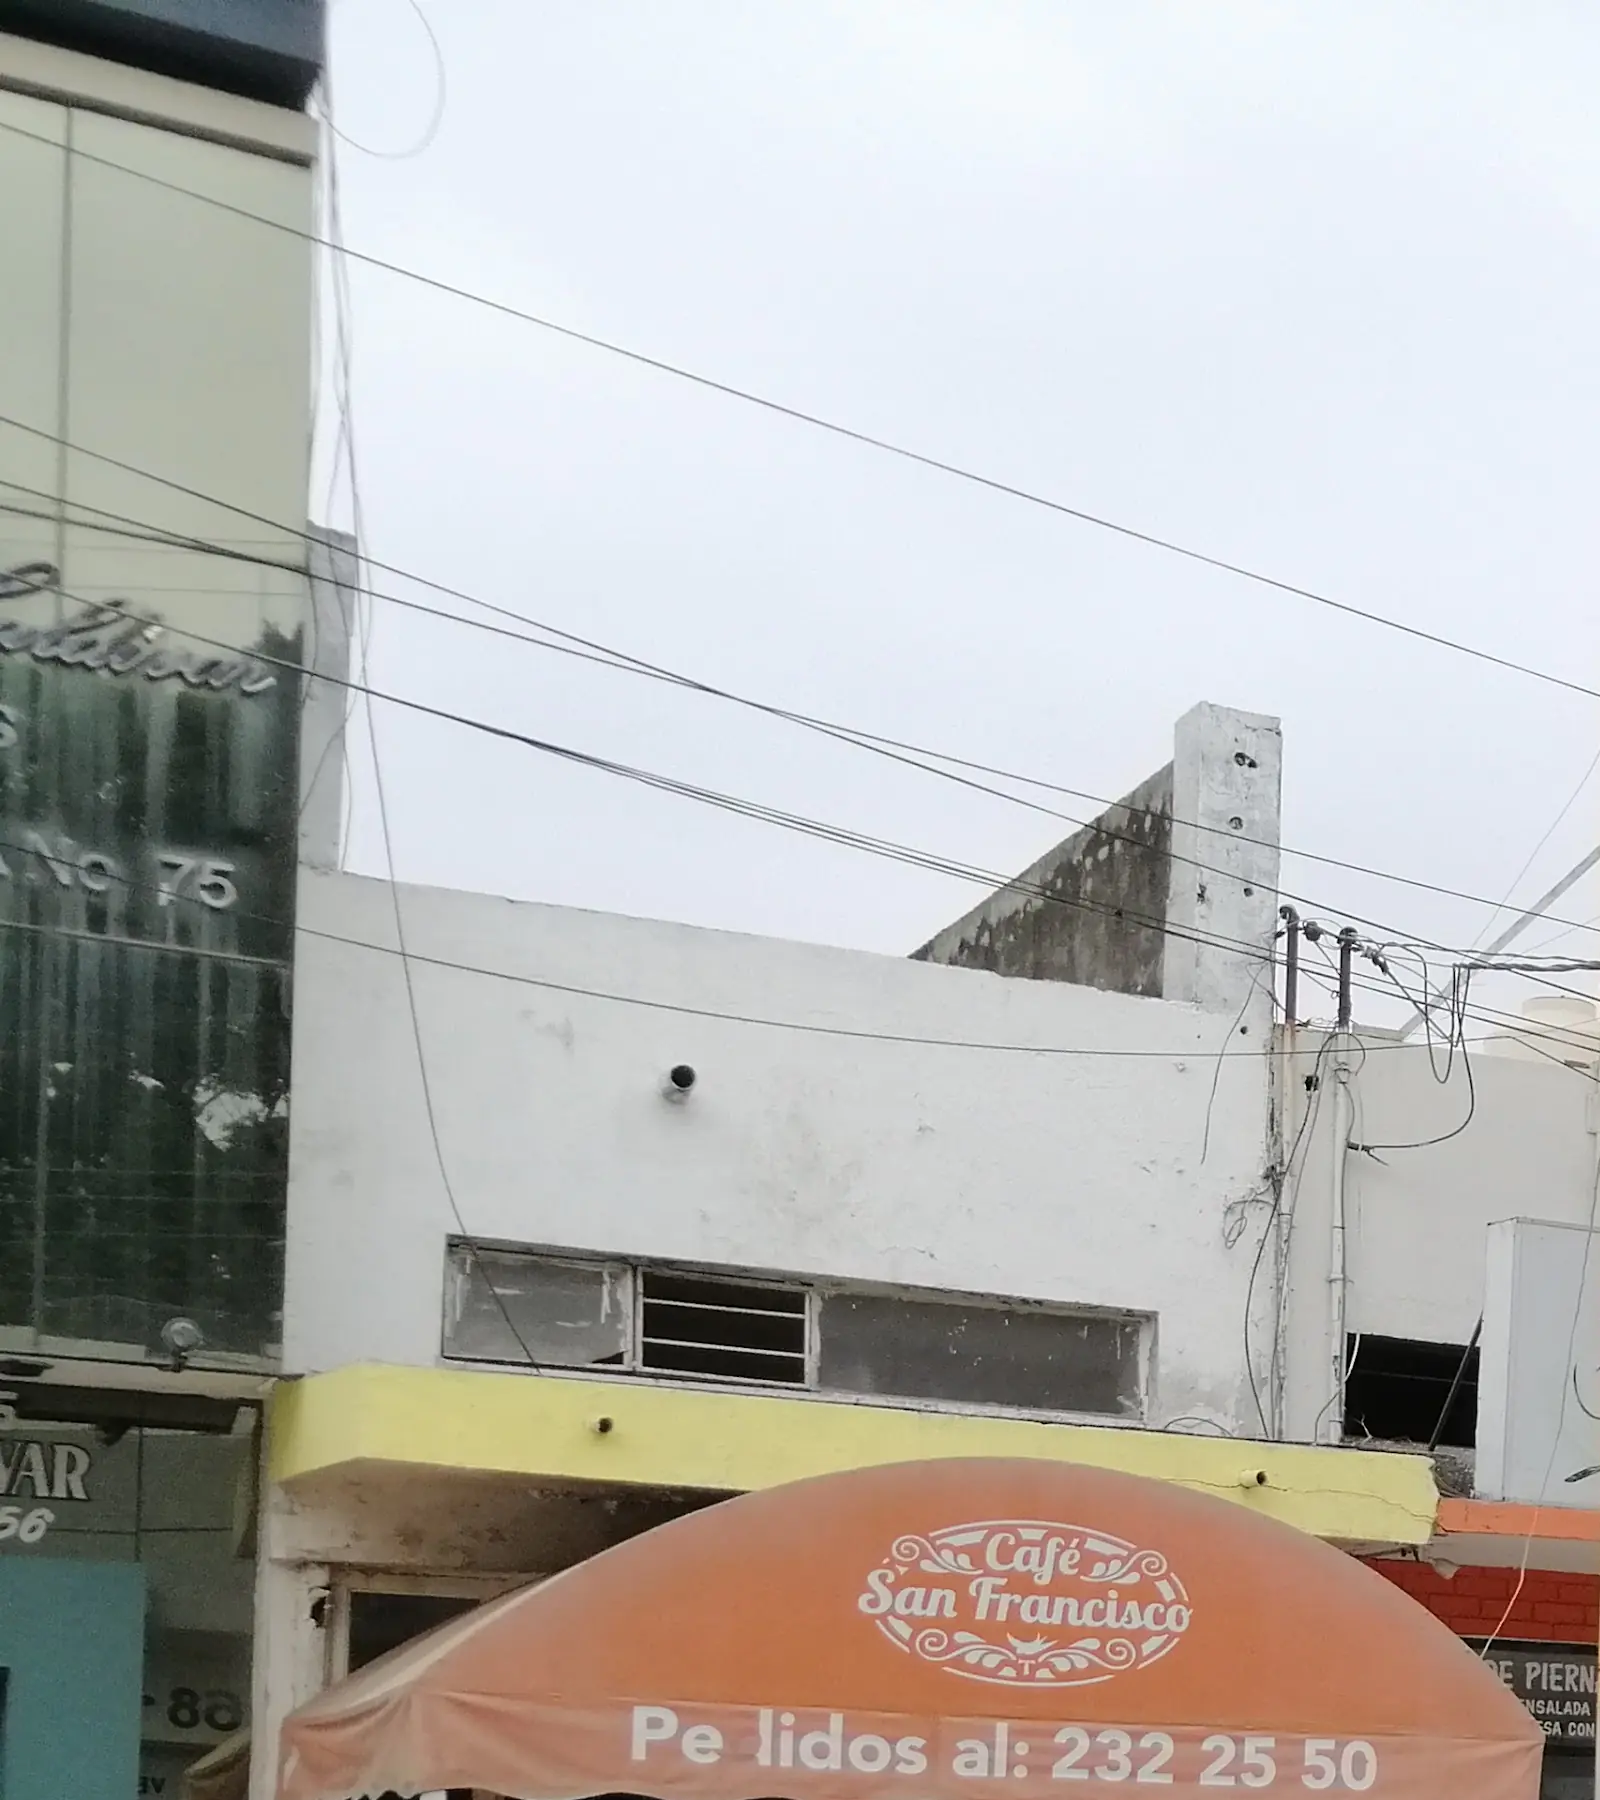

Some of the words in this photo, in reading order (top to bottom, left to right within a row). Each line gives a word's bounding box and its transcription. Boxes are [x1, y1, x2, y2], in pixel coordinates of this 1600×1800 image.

[158, 853, 239, 909] 75
[985, 1531, 1082, 1586] Café
[858, 1567, 958, 1619] San
[968, 1575, 1194, 1633] Francisco
[1524, 1661, 1599, 1694] PIERN
[952, 1721, 1030, 1779] al:
[1051, 1726, 1175, 1785] 232
[1200, 1734, 1277, 1789] 25
[1301, 1738, 1378, 1791] 50
[1567, 1720, 1595, 1738] CON
